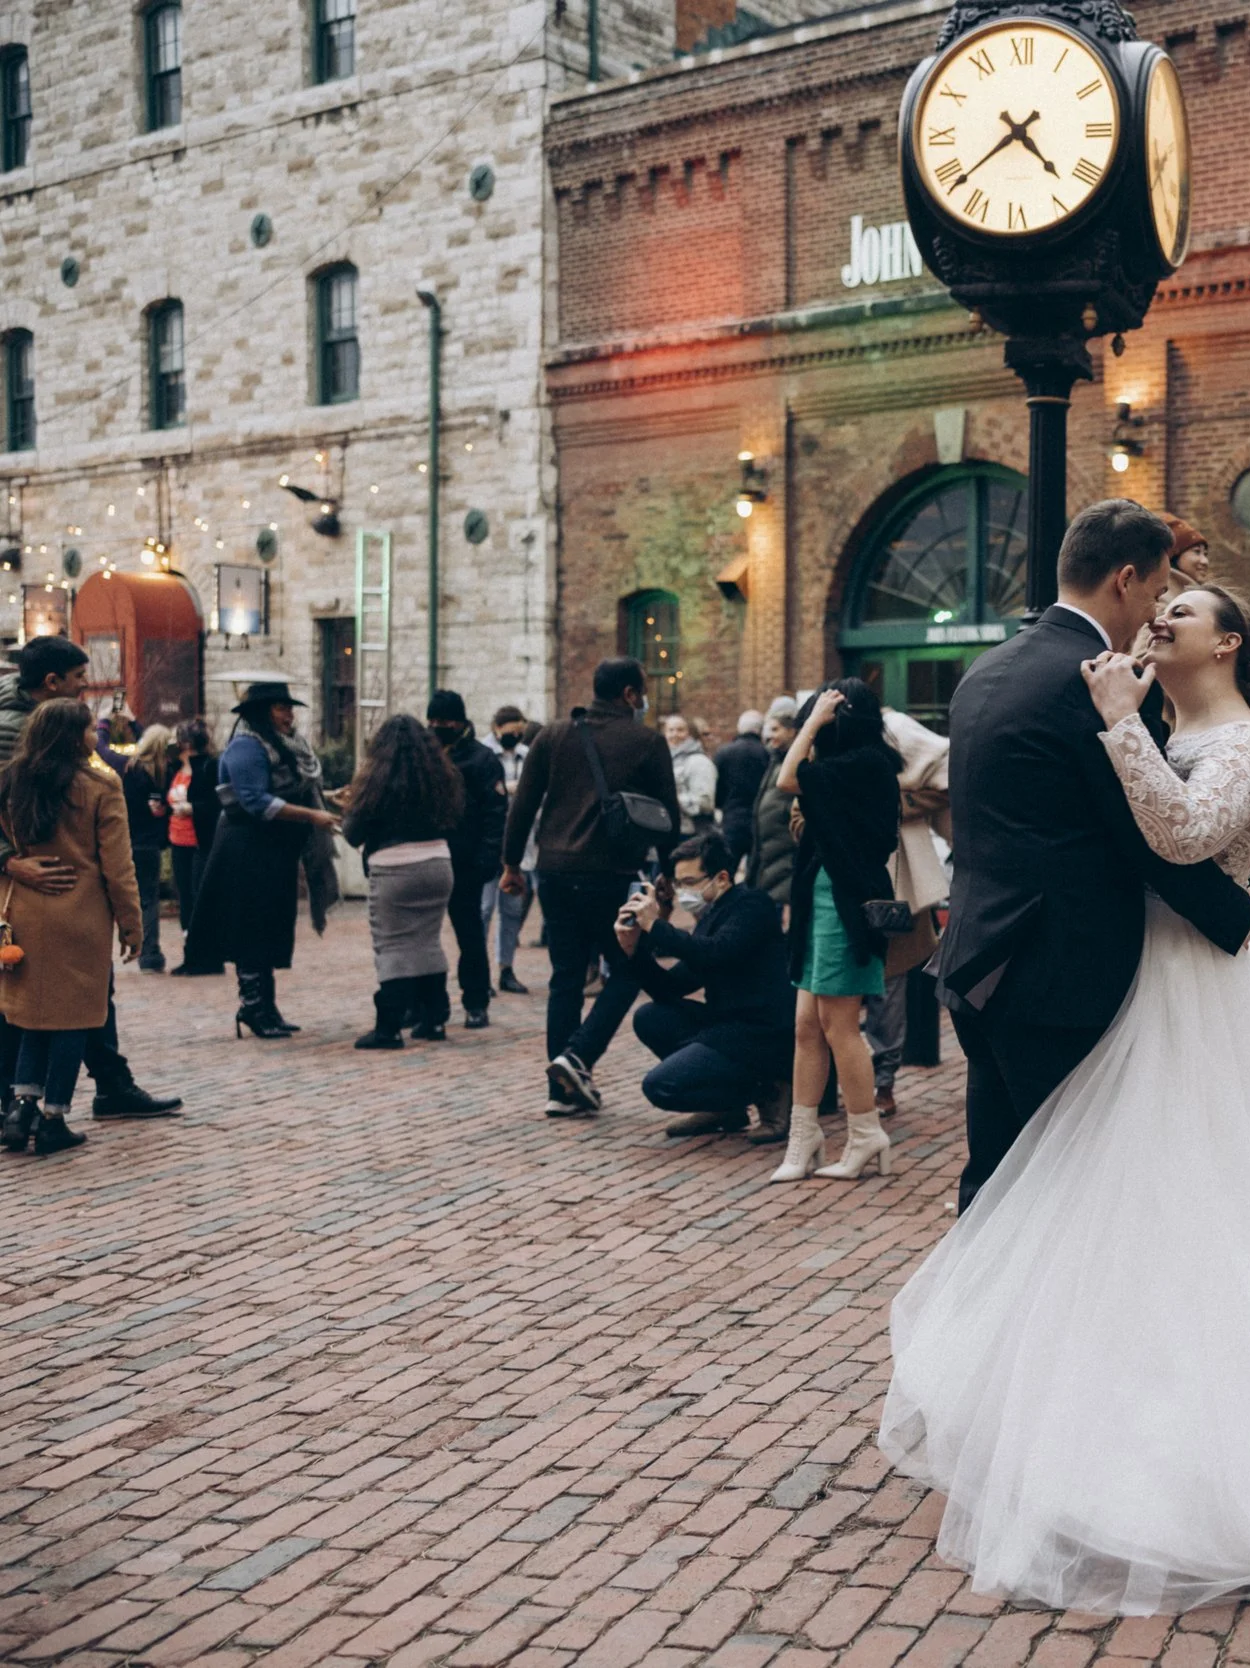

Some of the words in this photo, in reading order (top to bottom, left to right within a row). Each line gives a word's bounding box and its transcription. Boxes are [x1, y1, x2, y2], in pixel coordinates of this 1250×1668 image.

[968, 47, 996, 81] XI
[1010, 37, 1034, 66] XII
[1053, 48, 1069, 73] I
[940, 83, 967, 107] X
[1076, 78, 1103, 100] II
[929, 126, 955, 146] IX
[1085, 122, 1112, 138] III
[963, 188, 990, 223] VII
[841, 215, 923, 288] JOHN
